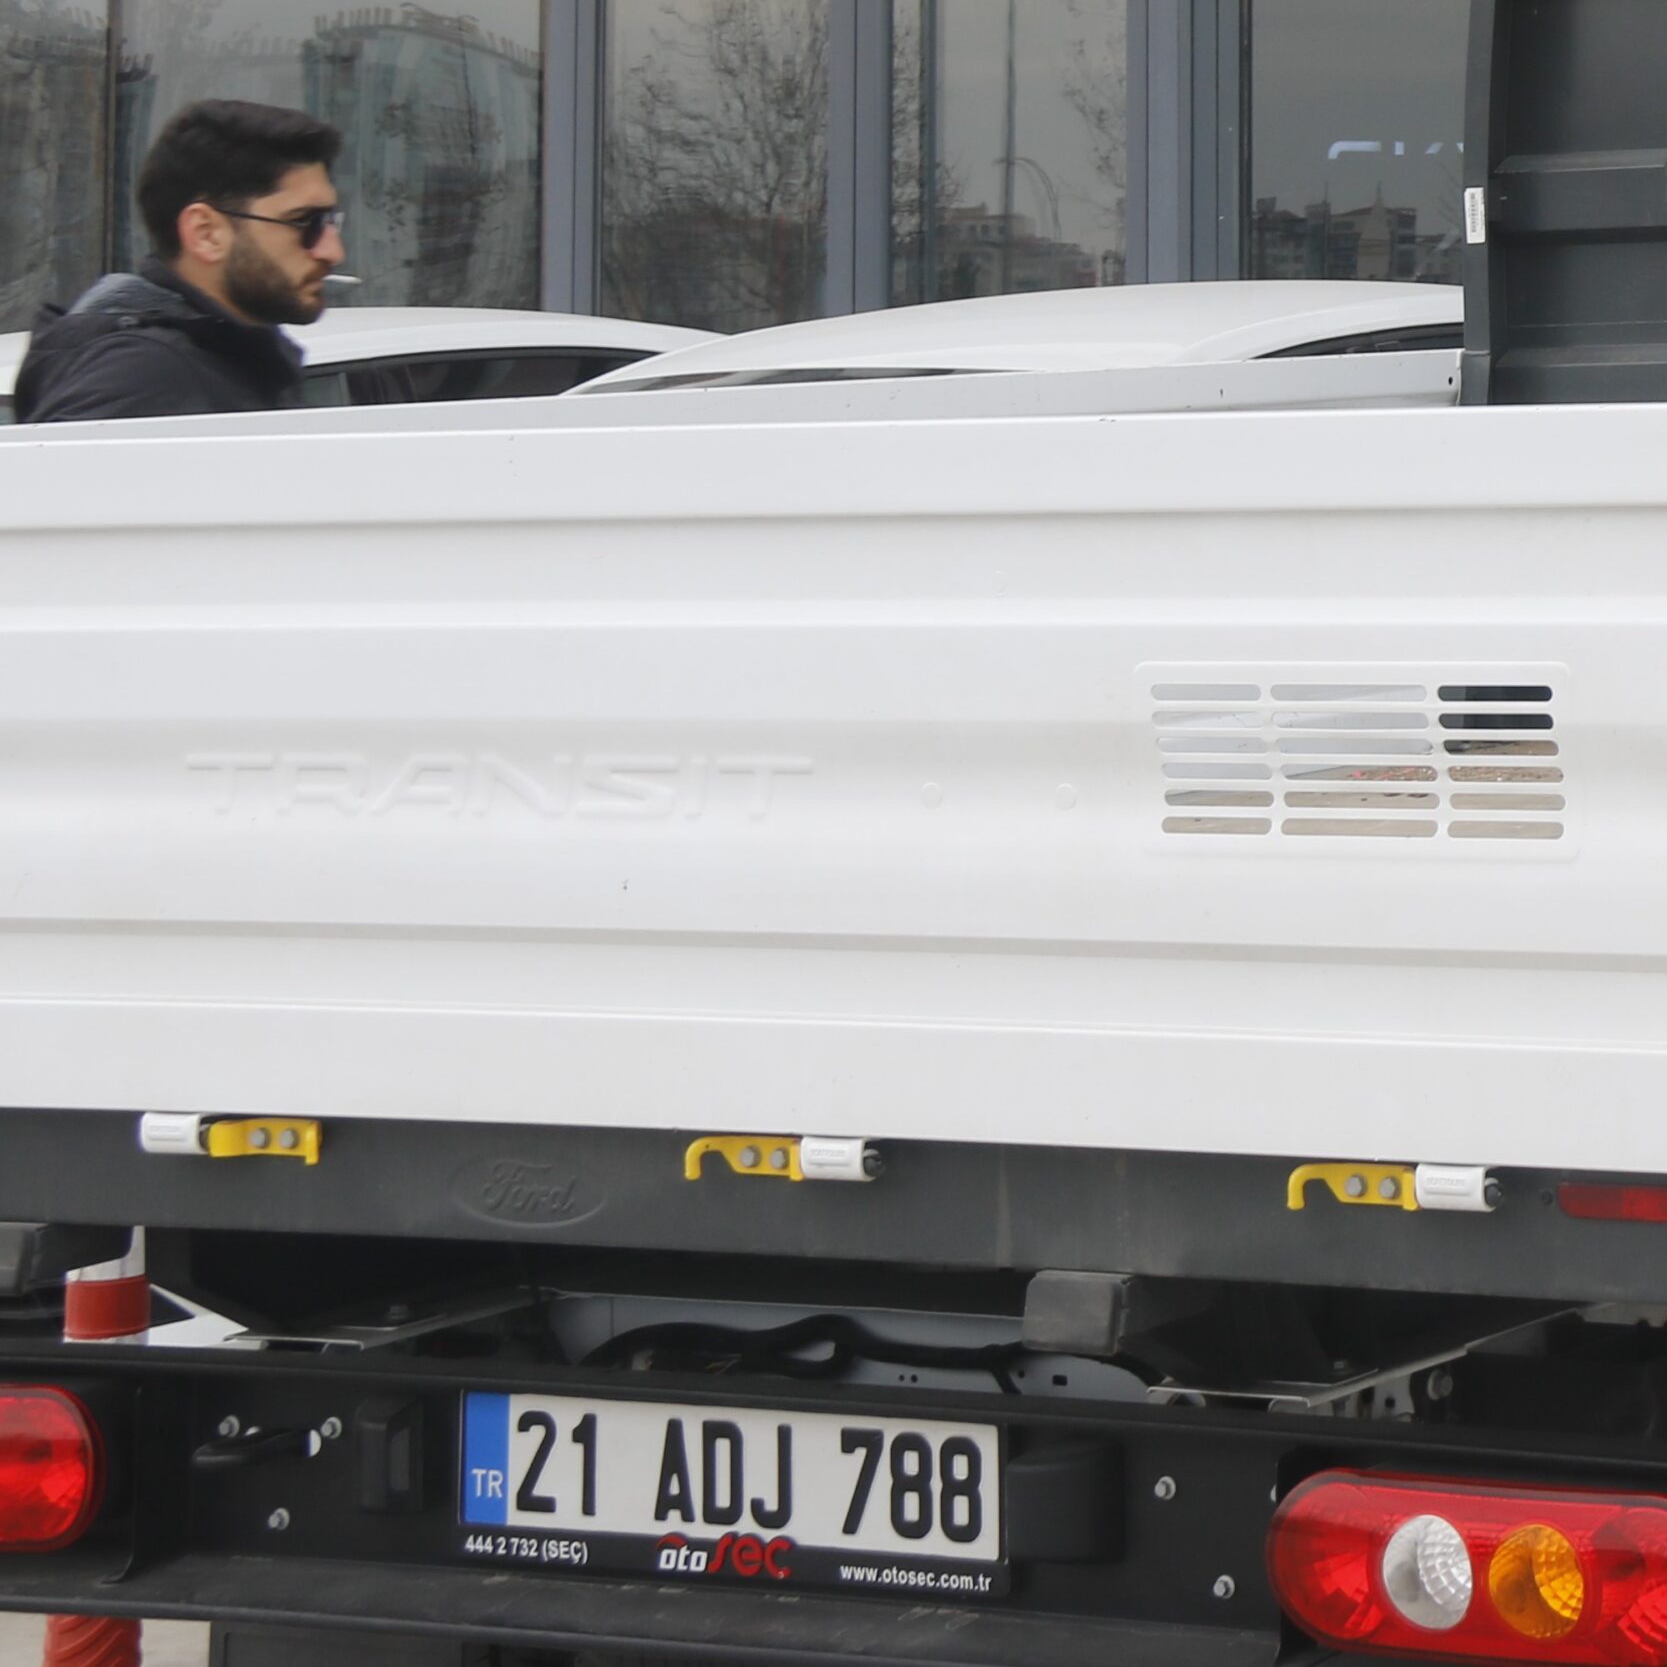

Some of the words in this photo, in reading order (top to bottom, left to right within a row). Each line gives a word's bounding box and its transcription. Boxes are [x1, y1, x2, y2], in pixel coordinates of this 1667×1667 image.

[185, 752, 814, 822] TRANSIT
[482, 1159, 578, 1212] Ford
[472, 1468, 503, 1497] TR
[516, 1410, 598, 1516] 21
[654, 1417, 792, 1529] ADJ
[841, 1427, 983, 1542] 788
[465, 1534, 494, 1554] 444
[497, 1537, 507, 1555] 2
[510, 1538, 539, 1558] 732
[542, 1539, 588, 1565] (SEÇ)
[840, 1564, 992, 1592] www.otosec.com.tr
